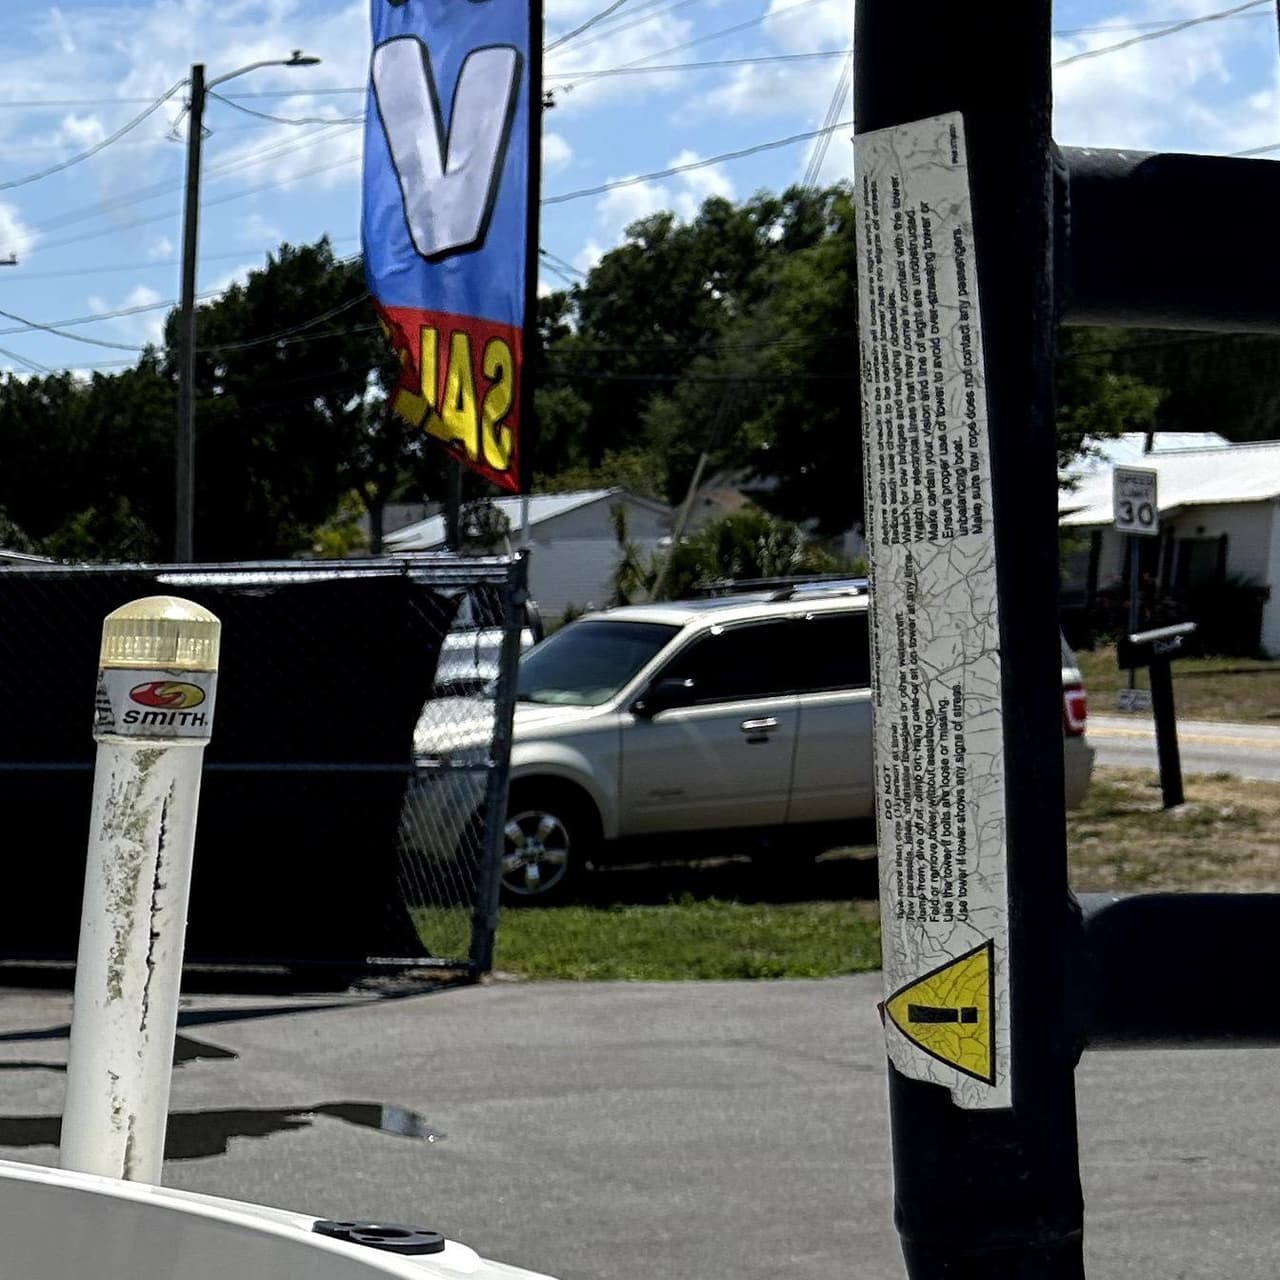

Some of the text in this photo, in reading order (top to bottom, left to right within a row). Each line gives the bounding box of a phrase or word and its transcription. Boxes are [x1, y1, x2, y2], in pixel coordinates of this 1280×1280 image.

[1119, 501, 1153, 525] 30
[123, 710, 205, 726] SMITH
[883, 765, 892, 820] DO NOT
